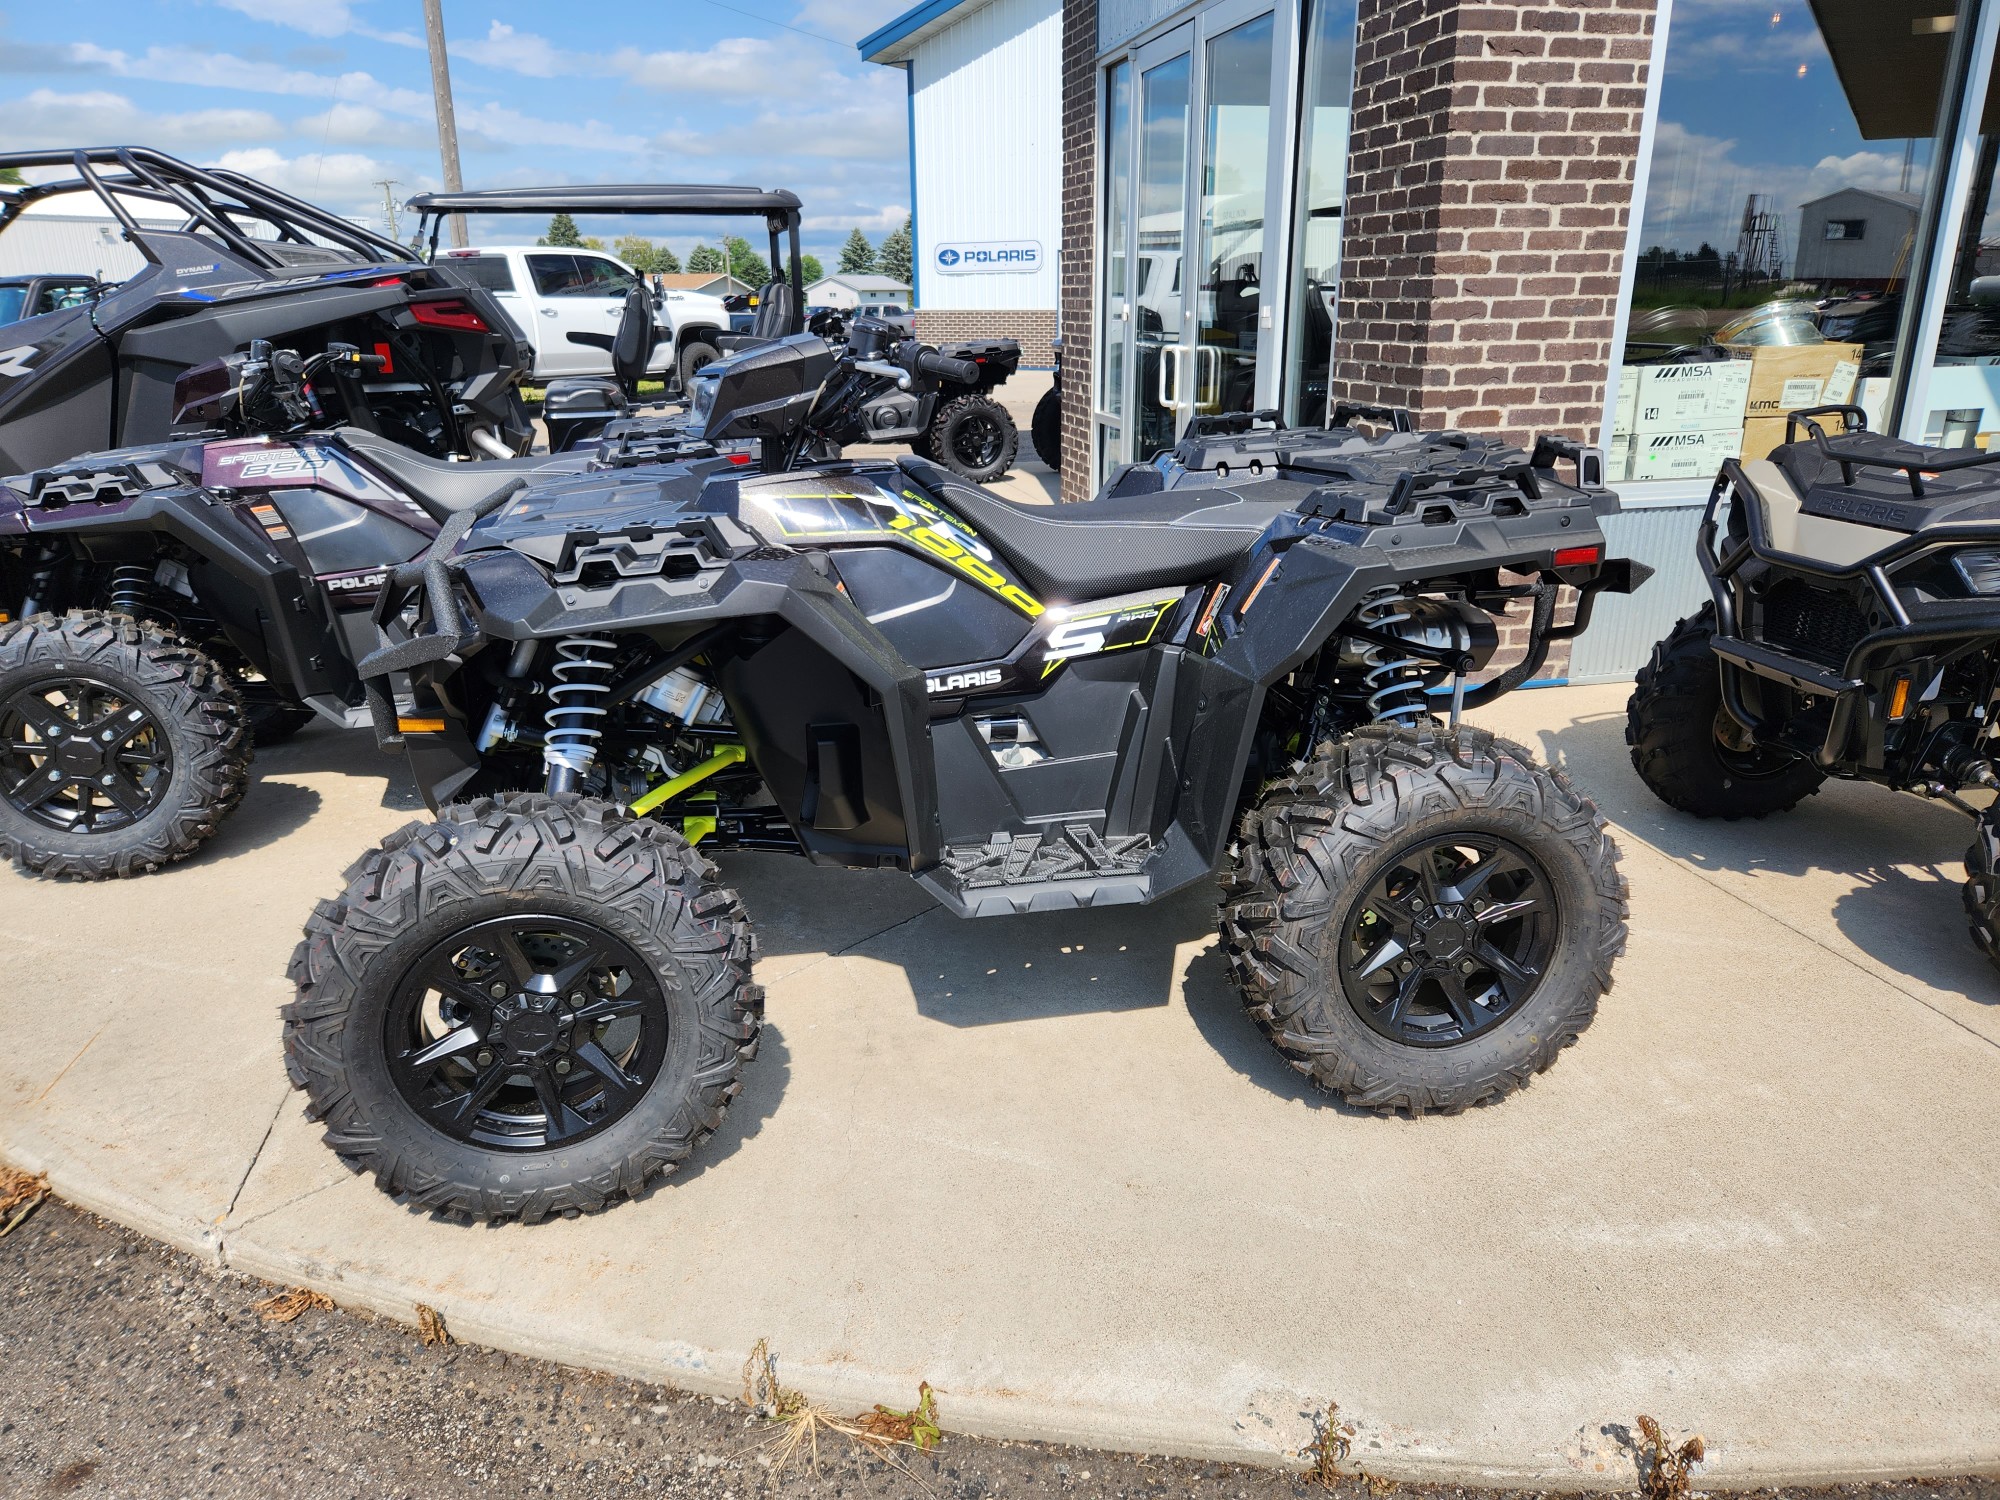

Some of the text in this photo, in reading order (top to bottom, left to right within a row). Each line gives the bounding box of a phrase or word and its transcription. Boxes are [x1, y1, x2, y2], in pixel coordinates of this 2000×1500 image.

[964, 249, 1036, 263] POLARIS
[1851, 348, 1862, 361] 14
[1681, 365, 1713, 378] MSA
[1646, 408, 1659, 419] 14
[1749, 400, 1780, 410] KMC
[1674, 434, 1705, 446] MSA
[217, 449, 330, 467] SPORTSMAN
[240, 459, 333, 479] 850
[902, 489, 978, 538] SPORTSMAN
[1816, 496, 1909, 524] POLARIS
[888, 514, 1047, 617] 1000
[1042, 616, 1106, 662] S
[658, 962, 684, 992] V2
